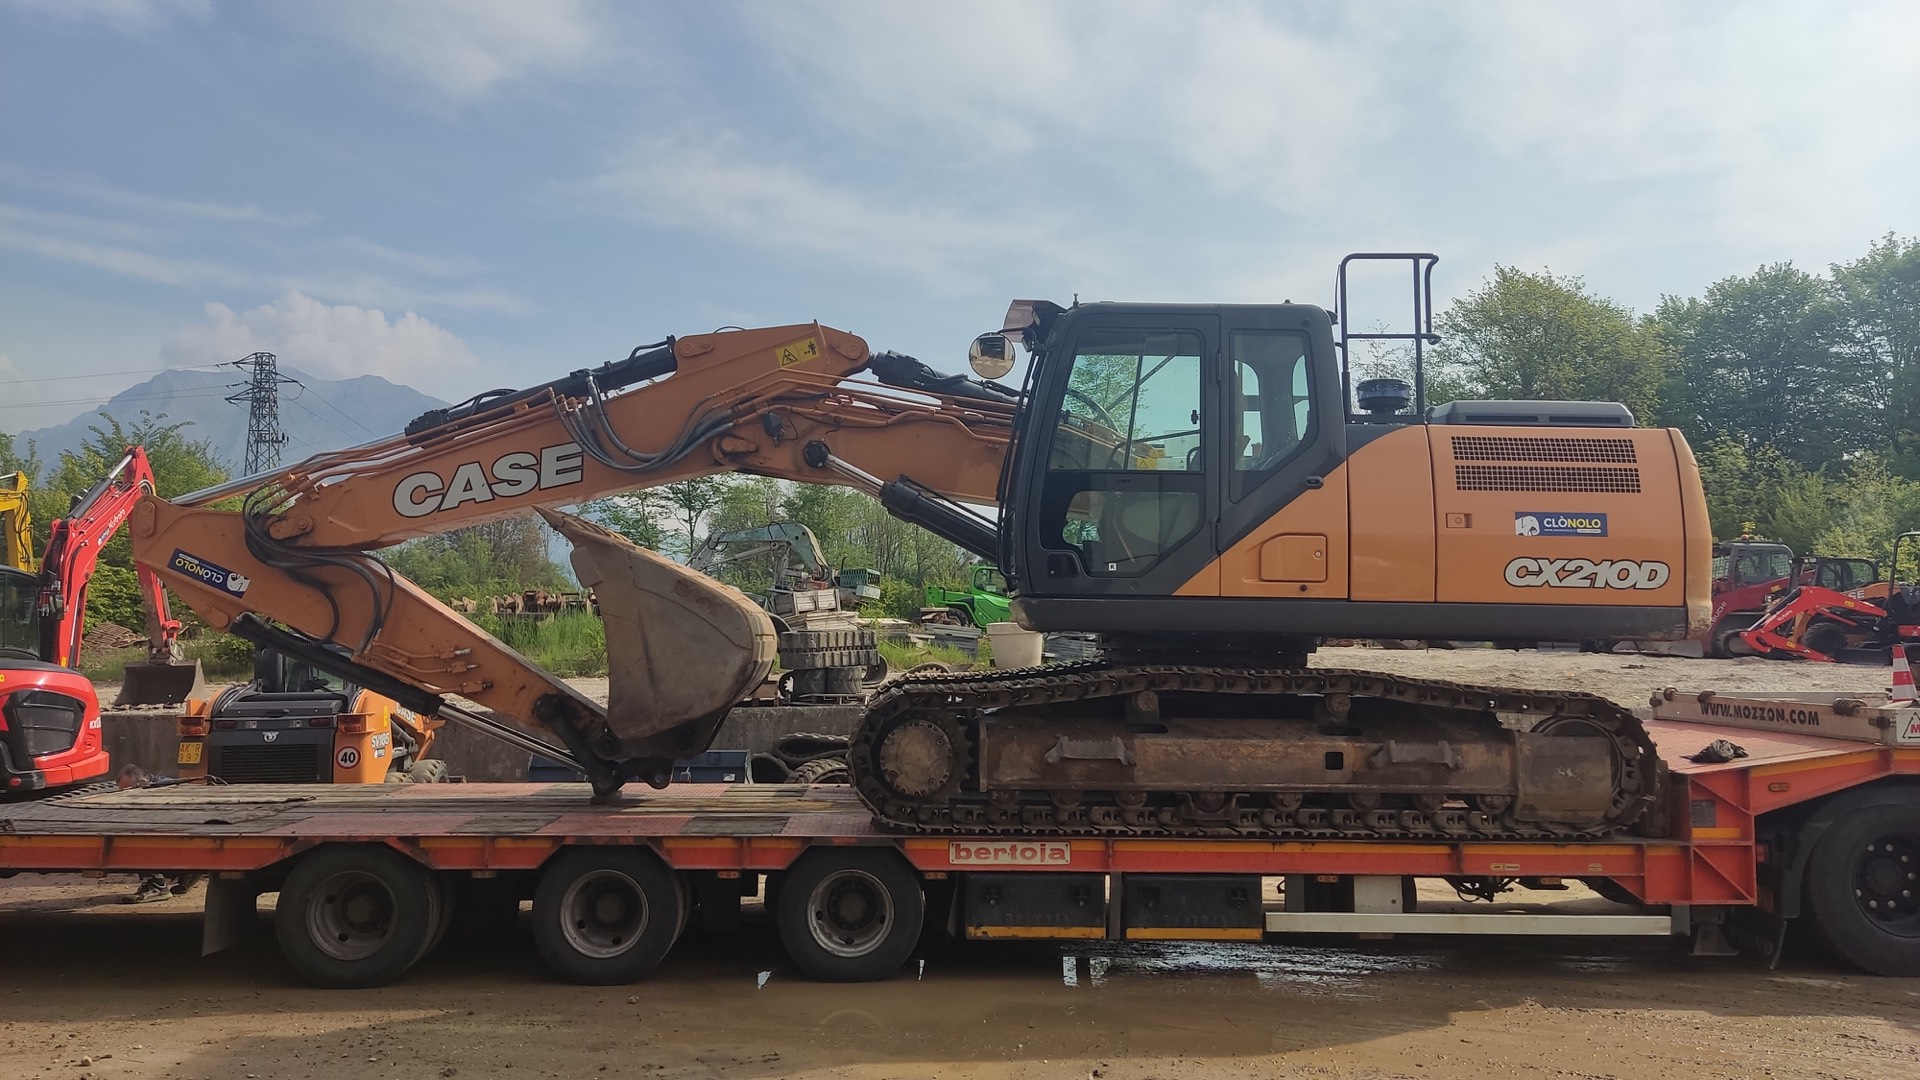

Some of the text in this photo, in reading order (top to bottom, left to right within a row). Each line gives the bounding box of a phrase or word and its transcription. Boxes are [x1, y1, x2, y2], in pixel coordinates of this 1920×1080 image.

[392, 441, 584, 518] CASE
[1503, 556, 1671, 590] CX210D
[1700, 702, 1821, 727] WWW.MOZZON.COM
[194, 743, 201, 753] R
[340, 751, 356, 764] 40
[954, 843, 1067, 863] bertoja
